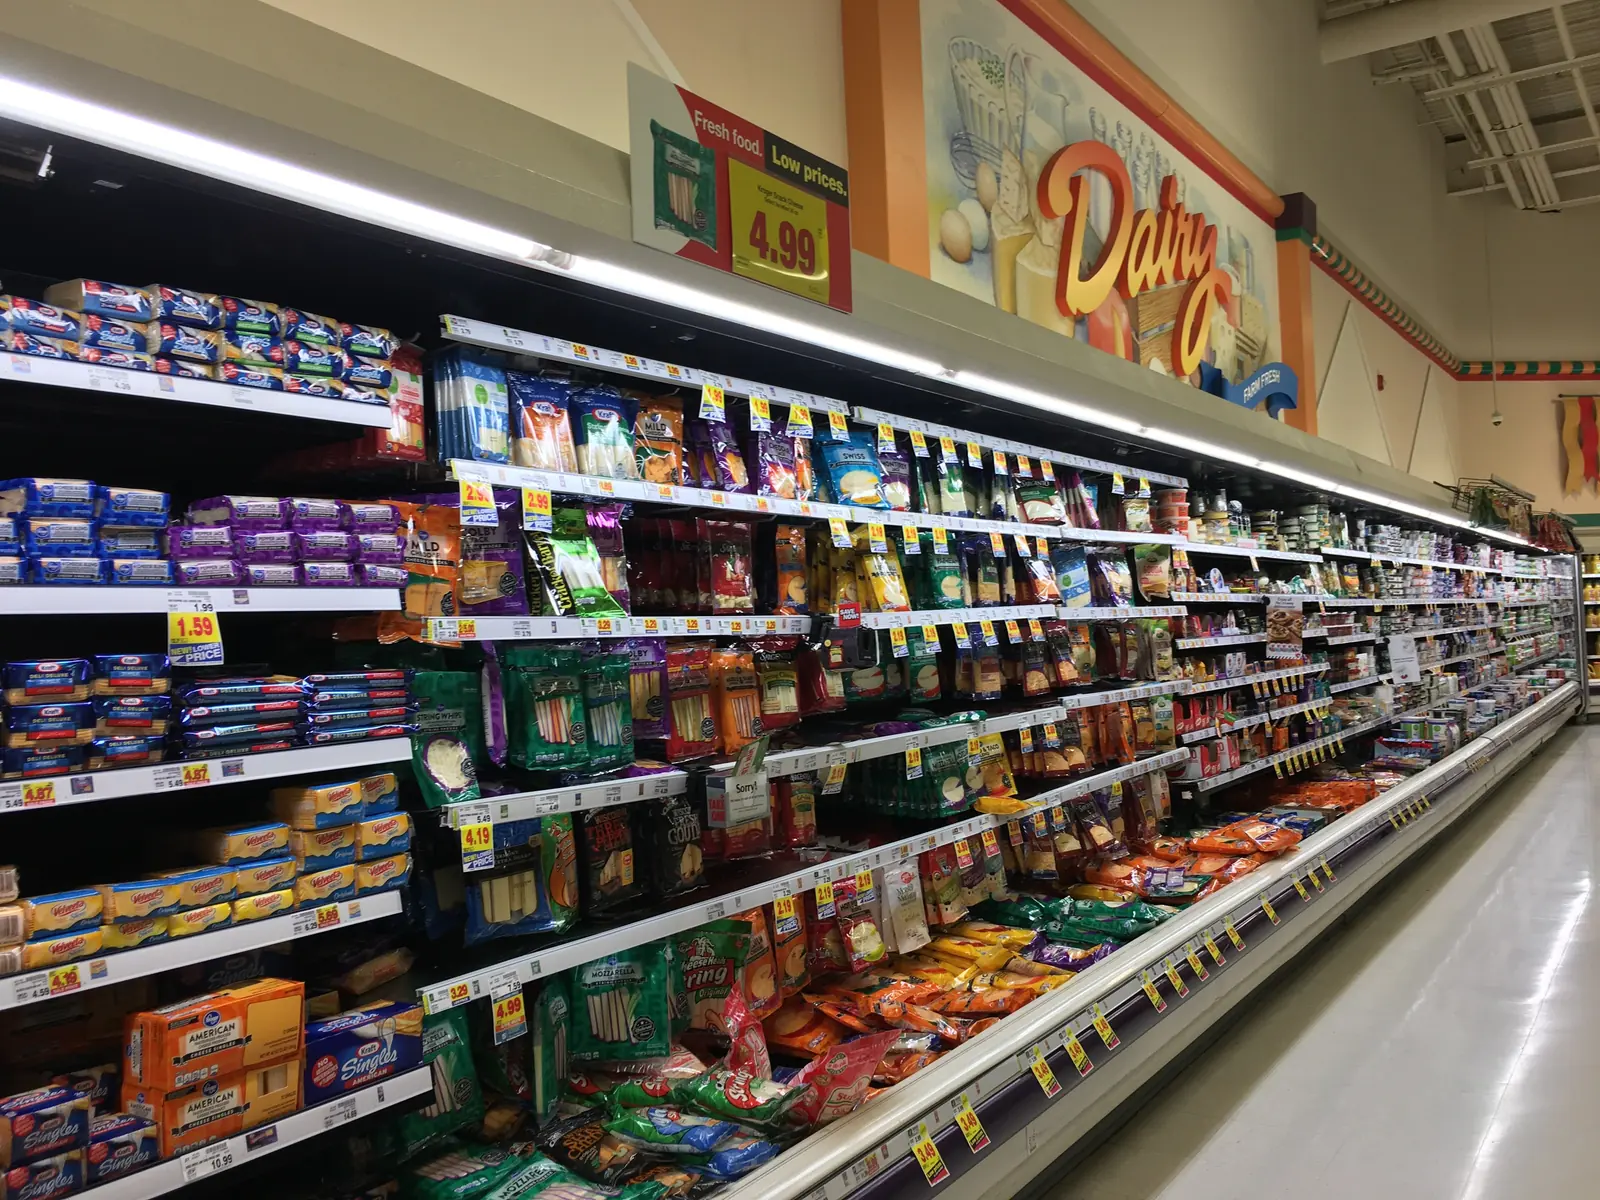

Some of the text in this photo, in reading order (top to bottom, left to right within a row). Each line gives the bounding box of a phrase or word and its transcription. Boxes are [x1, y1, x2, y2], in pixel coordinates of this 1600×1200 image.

[694, 110, 763, 157] Fresh food.
[772, 145, 847, 196] Low prices.
[749, 211, 815, 276] 4.99
[1037, 139, 1233, 377] Dairy
[1261, 369, 1280, 388] FRESH
[843, 452, 865, 460] SWISS
[527, 492, 548, 509] 2.99
[194, 603, 214, 612] 1.99
[177, 617, 213, 637] 1.59
[185, 649, 222, 662] PRICE
[192, 643, 220, 653] LOWER
[168, 779, 183, 788] 5.49
[184, 769, 207, 781] 4.87
[25, 787, 53, 801] 4.87
[736, 781, 758, 793] Sorry!
[477, 815, 491, 824] 5.49
[465, 827, 490, 846] 4.19
[473, 855, 493, 867] PRICE
[859, 874, 871, 887] 2.19
[818, 887, 831, 900] 2.19
[777, 900, 792, 915] 2.19
[591, 968, 635, 978] MOZZARELLA
[32, 988, 50, 999] 4.59
[450, 984, 468, 999] 3.29
[496, 998, 521, 1019] 4.99
[189, 1022, 235, 1043] AMERICAN
[190, 1041, 236, 1059] CHEESE SINGLES
[360, 1044, 377, 1056] Kraft
[341, 1048, 398, 1081] Singles
[352, 1068, 388, 1086] AMERICAN
[187, 1091, 234, 1113] AMERICAN
[188, 1109, 234, 1129] CHEESE SINGLES
[960, 1111, 977, 1131] 3.49
[23, 1122, 80, 1150] Singles
[917, 1142, 936, 1164] 3.49
[98, 1151, 149, 1176] Singles
[211, 1154, 233, 1170] 10.99
[18, 1174, 75, 1200] Singles
